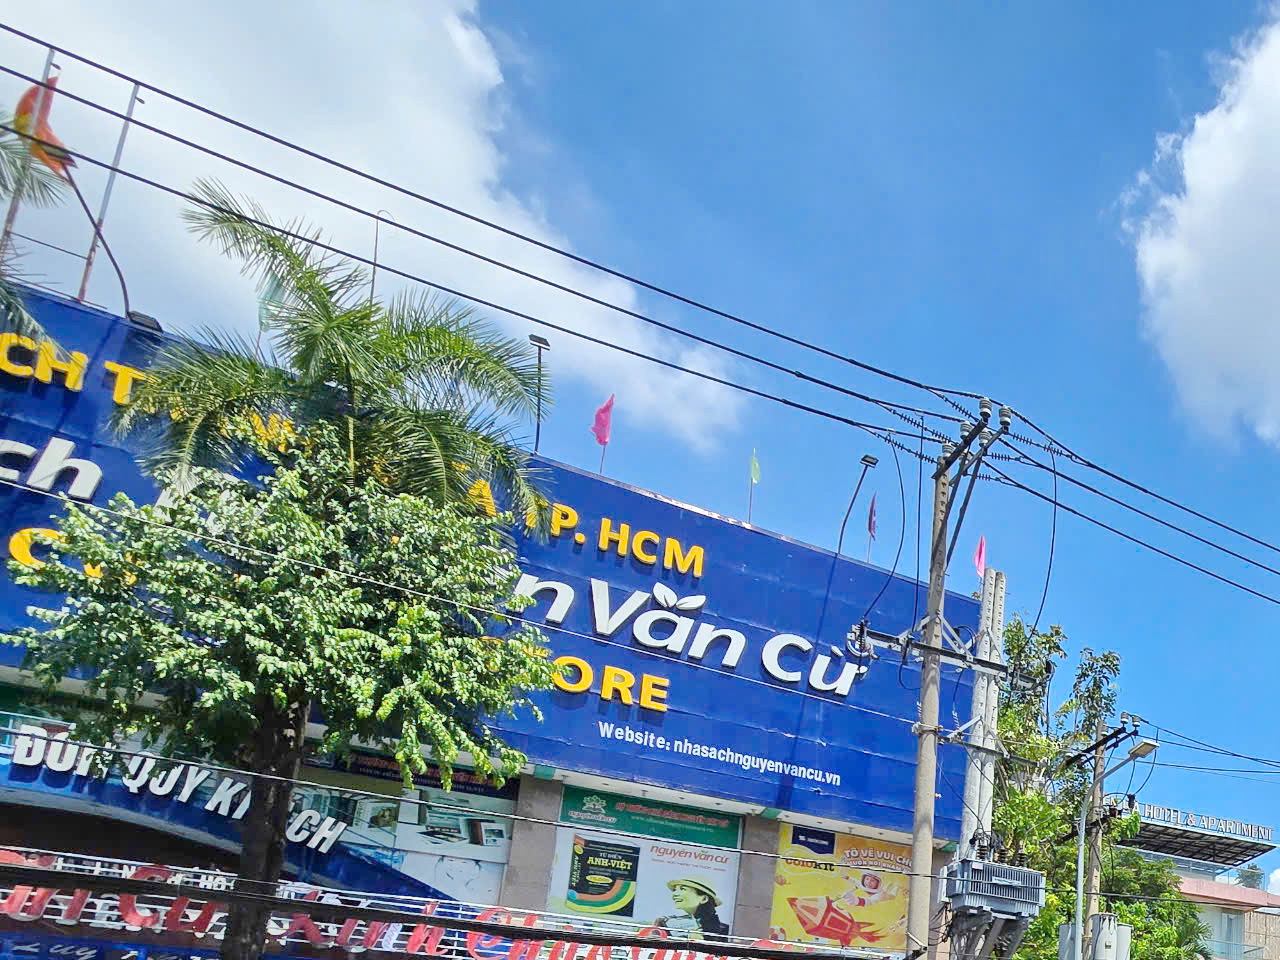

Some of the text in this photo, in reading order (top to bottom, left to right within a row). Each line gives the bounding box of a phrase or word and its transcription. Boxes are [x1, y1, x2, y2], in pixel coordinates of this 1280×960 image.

[598, 518, 704, 578] HCM
[590, 577, 868, 696] Văn Cừ
[598, 720, 841, 786] Website: nhasachnguyenvancu.vn
[1145, 804, 1186, 825] HOTEL
[1187, 812, 1196, 827] &
[1200, 815, 1273, 841] APARTMENT
